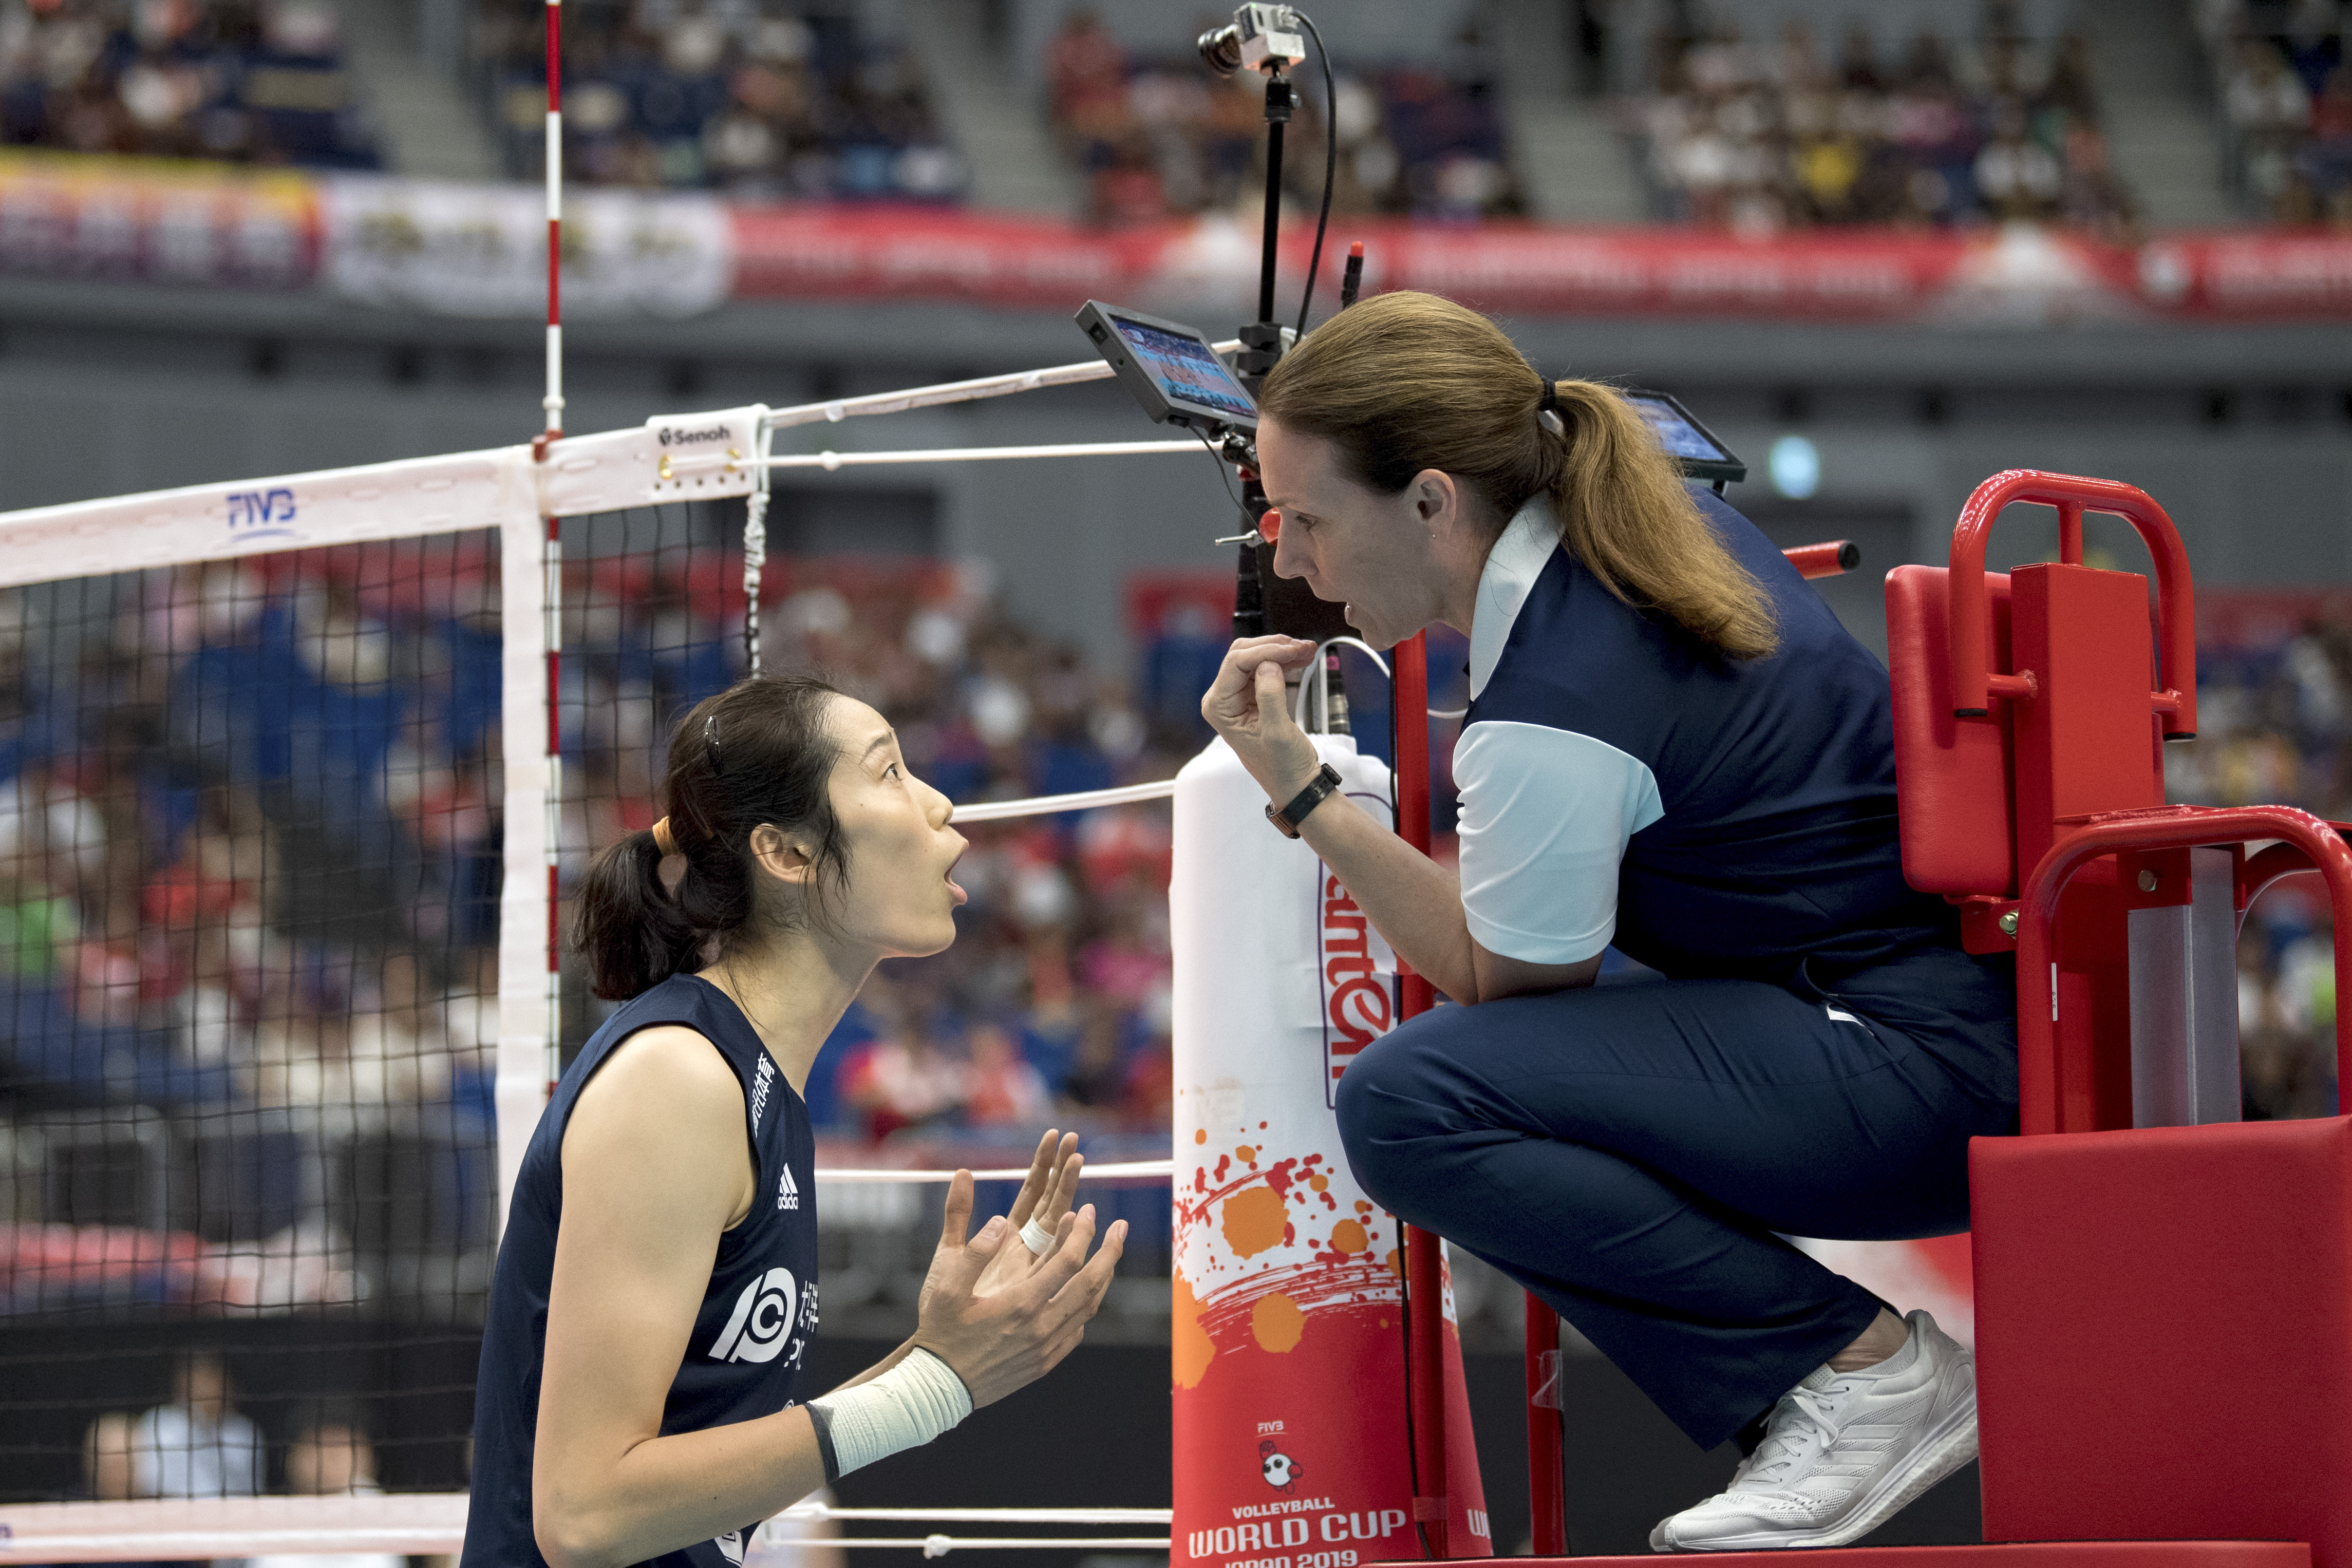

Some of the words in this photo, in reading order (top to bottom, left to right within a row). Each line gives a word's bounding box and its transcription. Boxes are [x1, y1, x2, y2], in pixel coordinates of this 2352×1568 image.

[674, 426, 730, 445] Senoh
[227, 487, 296, 527] FIVB
[777, 1193, 798, 1210] adida
[1257, 1421, 1284, 1433] FIVB
[1232, 1498, 1335, 1520] VOLLEYBALL
[1188, 1518, 1309, 1559] WORLD
[1320, 1509, 1406, 1542] CUP
[1296, 1550, 1358, 1568] 2019
